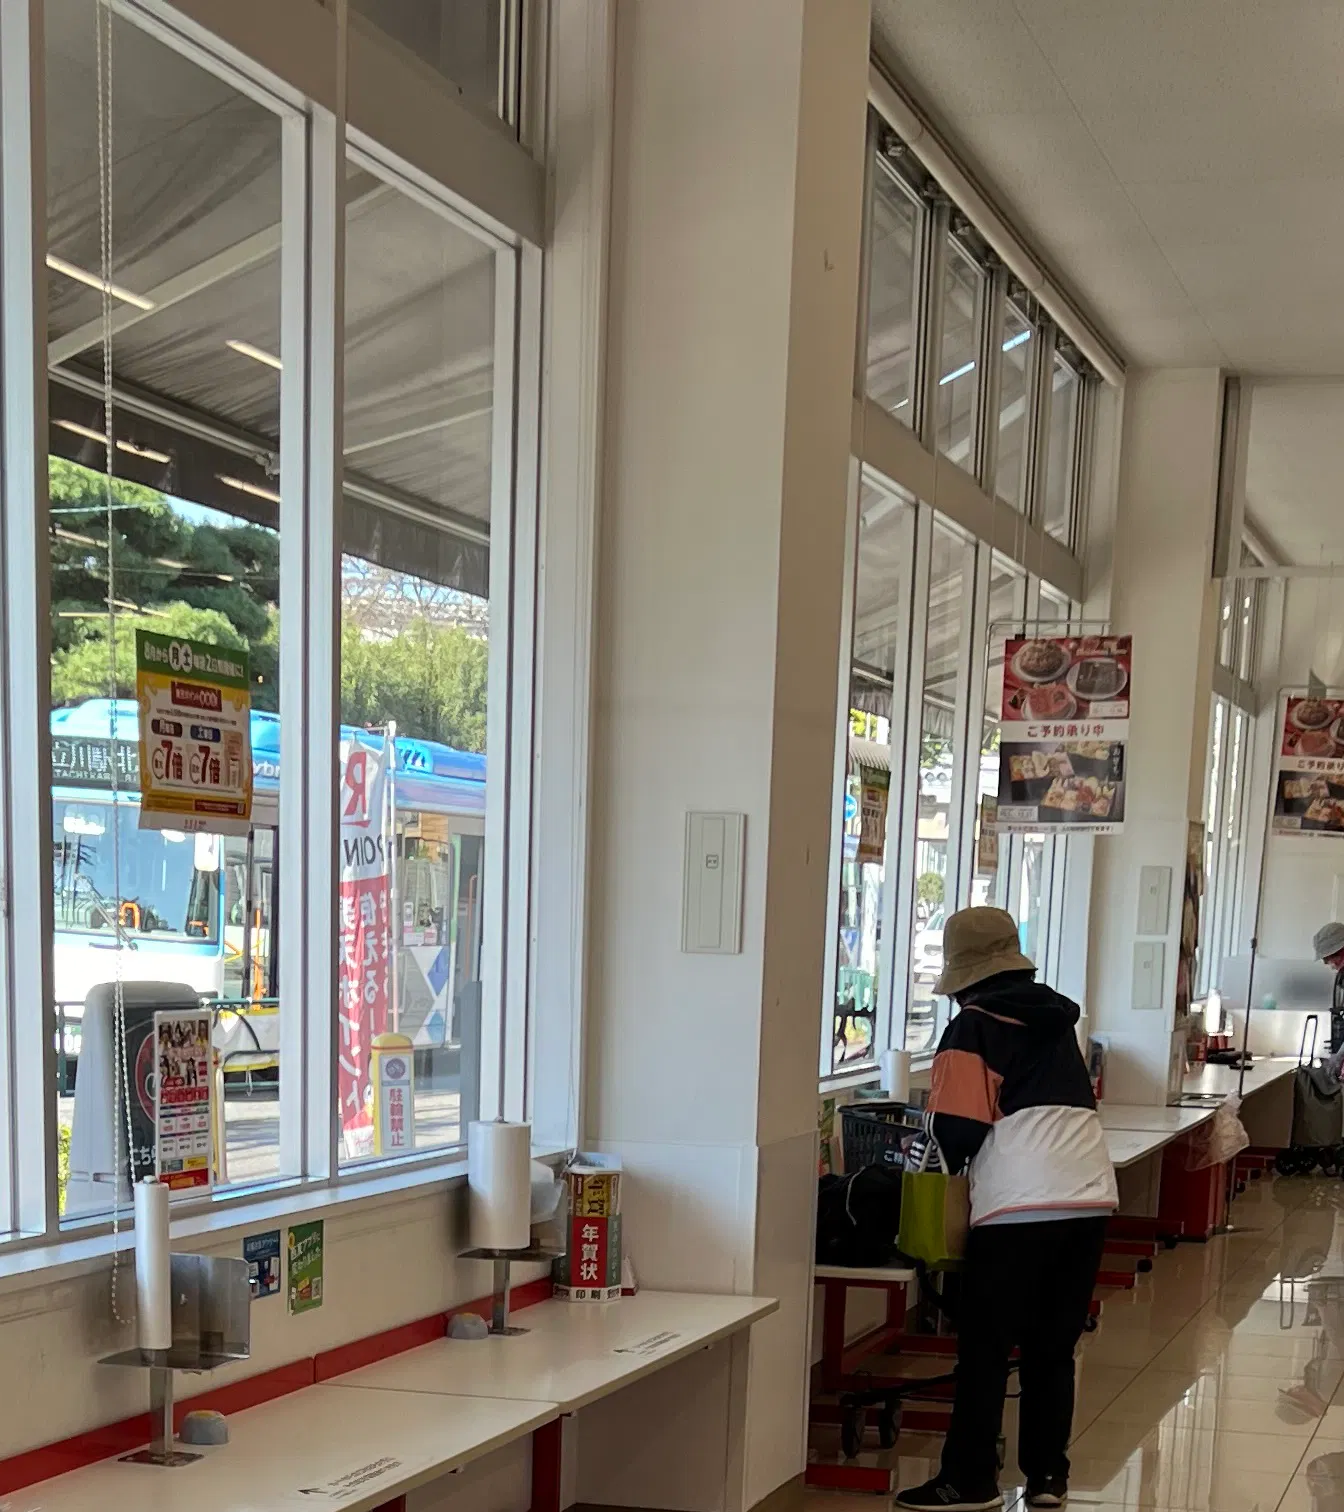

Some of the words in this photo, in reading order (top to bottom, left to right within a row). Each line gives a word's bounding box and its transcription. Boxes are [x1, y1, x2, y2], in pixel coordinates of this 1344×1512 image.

[52, 741, 139, 773] 立川駅北
[581, 1223, 600, 1281] 年賀状
